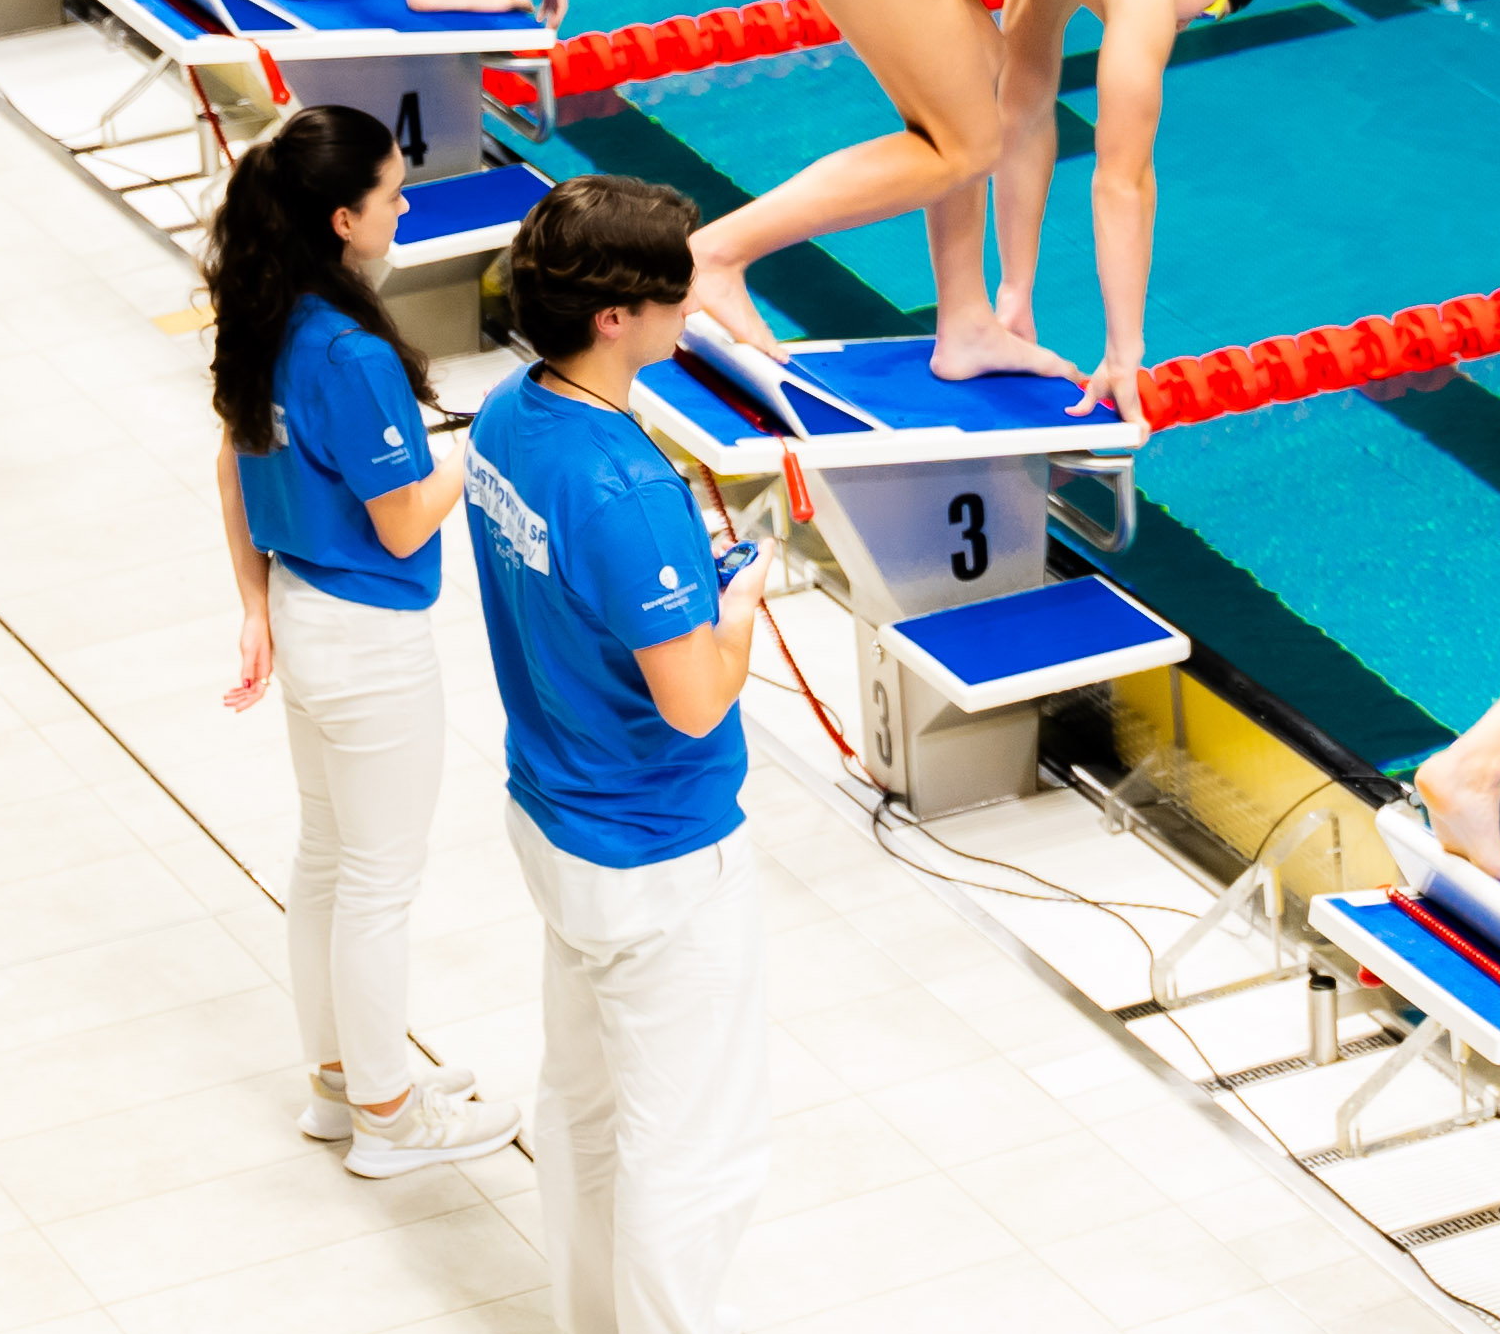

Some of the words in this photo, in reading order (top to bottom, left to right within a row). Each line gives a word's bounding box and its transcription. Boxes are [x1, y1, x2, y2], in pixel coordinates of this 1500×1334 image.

[396, 92, 427, 167] 4
[948, 493, 989, 582] 3
[873, 680, 892, 767] 3
